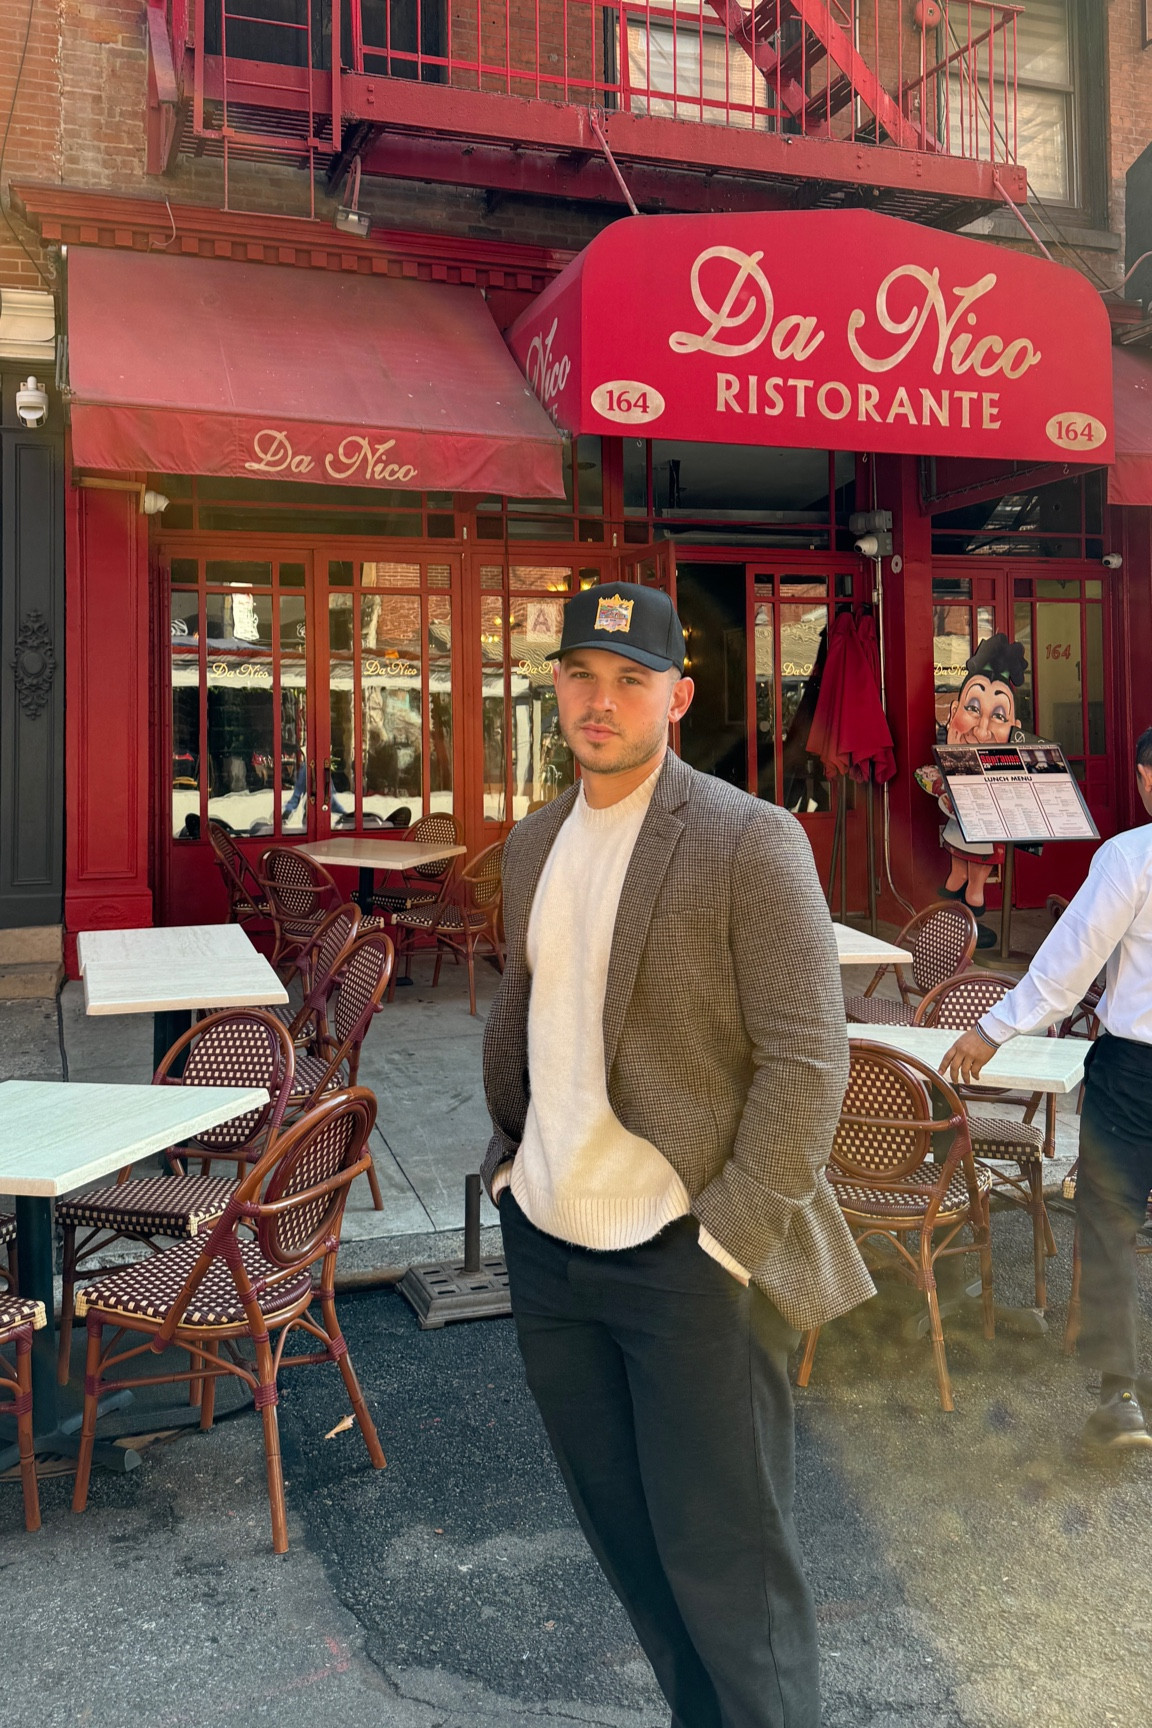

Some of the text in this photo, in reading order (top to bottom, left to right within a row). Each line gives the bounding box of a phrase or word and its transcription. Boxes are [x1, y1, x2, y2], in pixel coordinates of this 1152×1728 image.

[668, 245, 1041, 379] Da Nico
[526, 317, 571, 402] Nico
[605, 389, 650, 414] 164
[716, 372, 1002, 430] RISTORANTE
[1055, 420, 1094, 442] 164
[244, 429, 418, 482] Da Nico
[532, 608, 551, 632] A
[1045, 644, 1071, 660] 164
[211, 663, 268, 679] Da Nico
[363, 660, 417, 676] Da Nico
[517, 660, 537, 674] Da
[781, 662, 800, 676] Da
[1011, 774, 1032, 782] MENU
